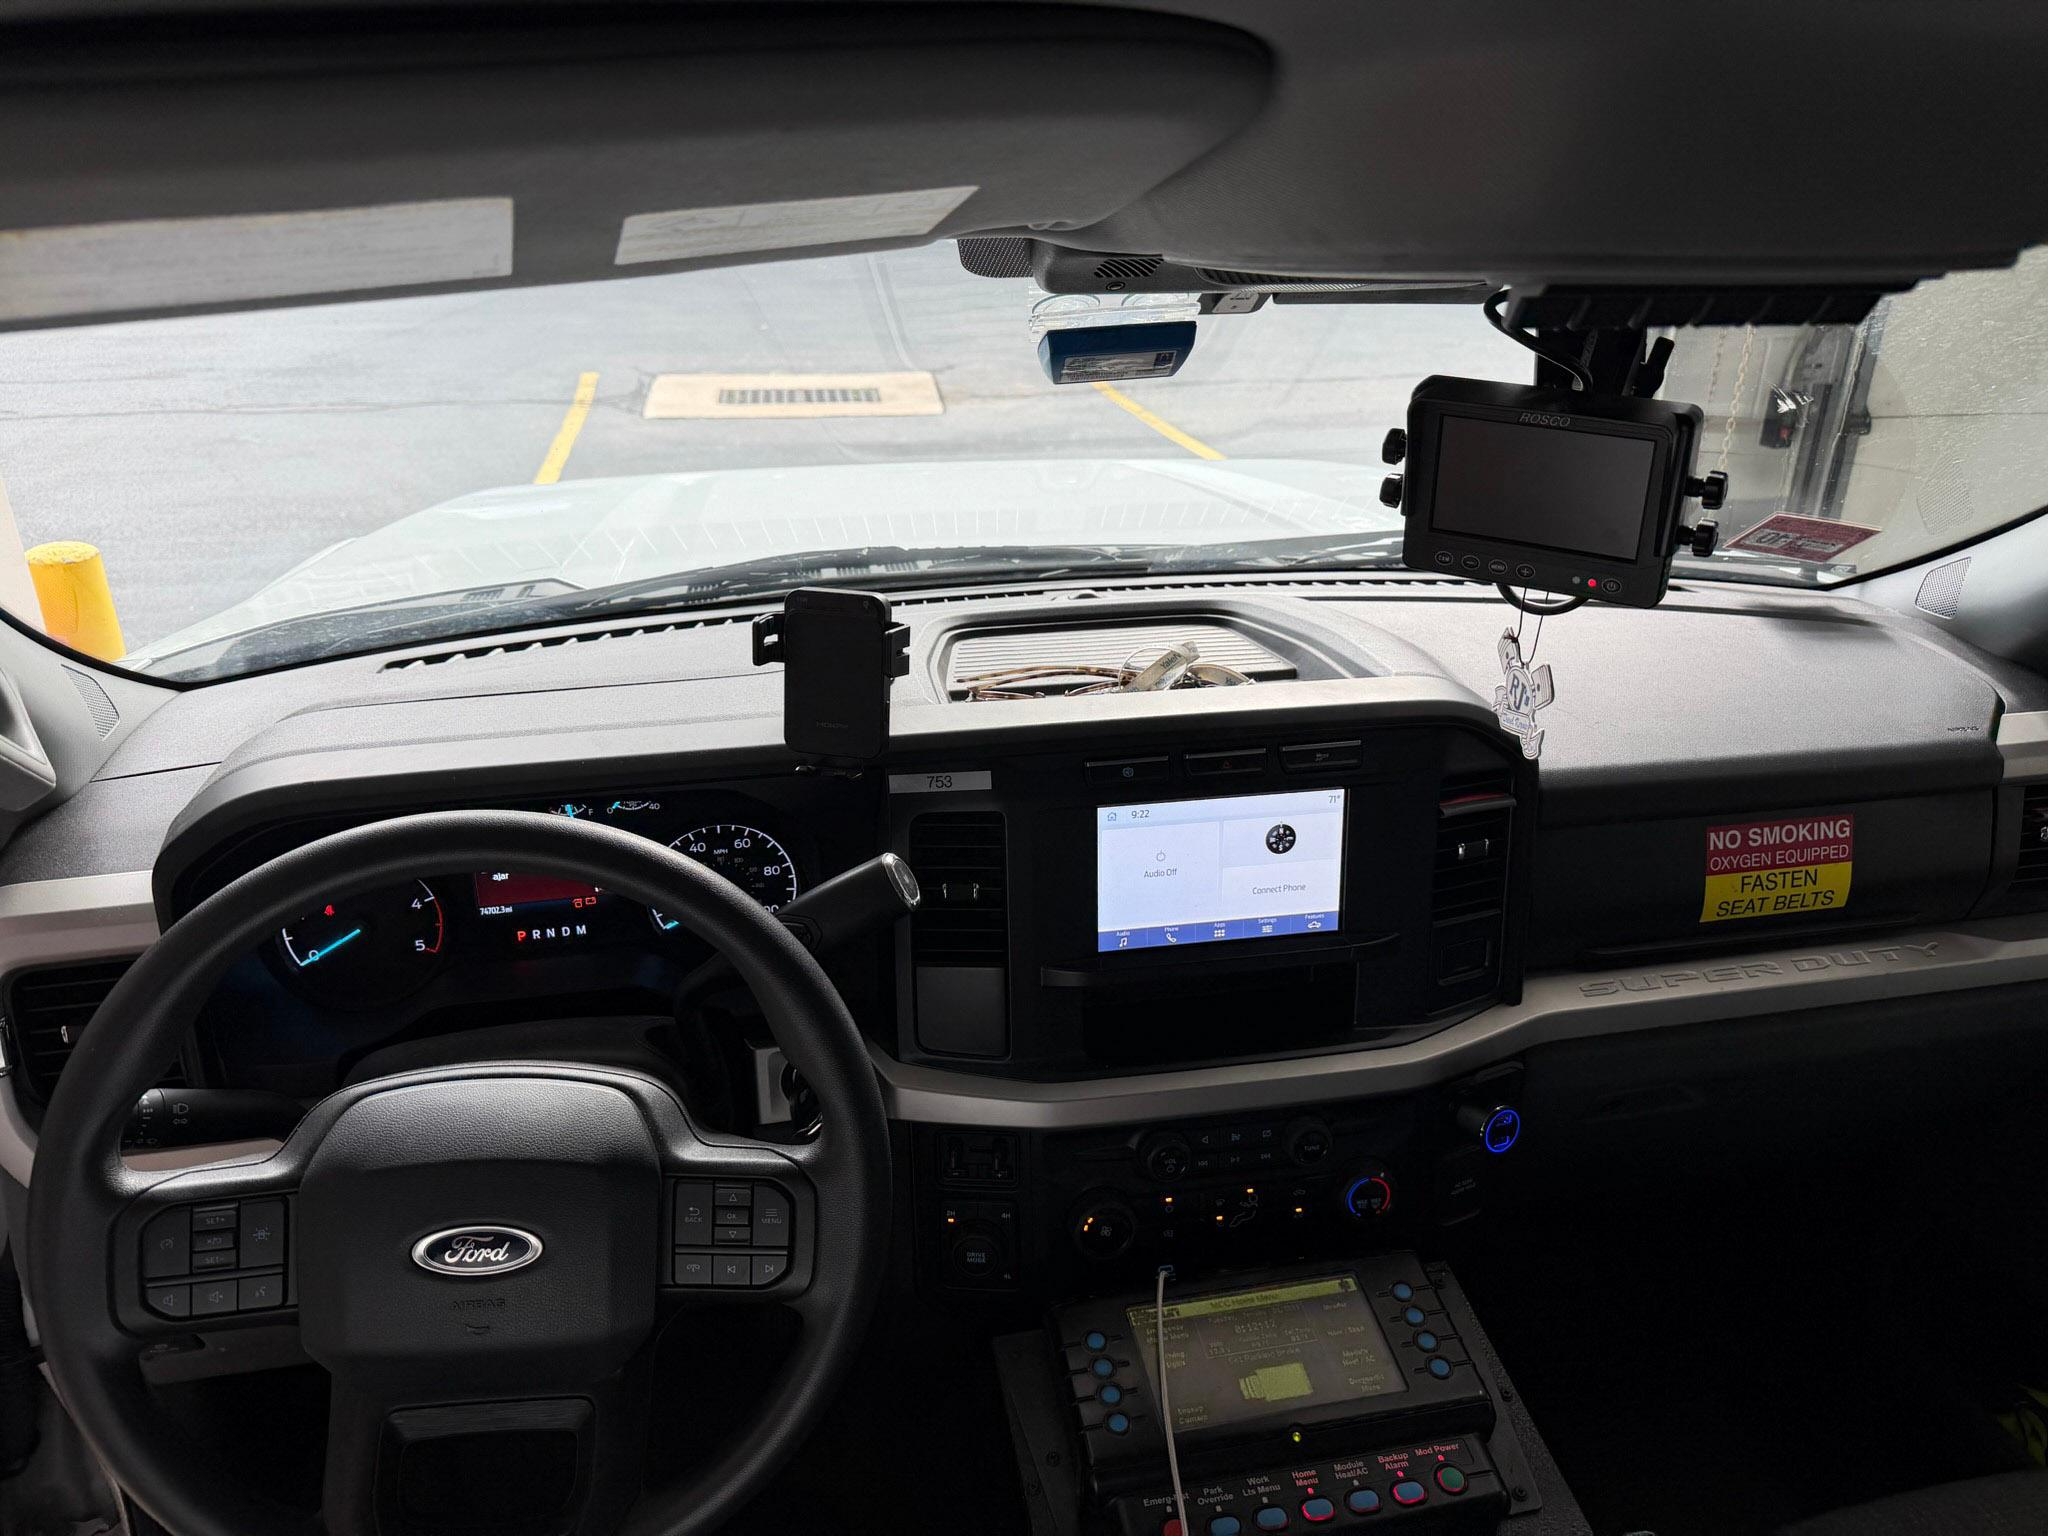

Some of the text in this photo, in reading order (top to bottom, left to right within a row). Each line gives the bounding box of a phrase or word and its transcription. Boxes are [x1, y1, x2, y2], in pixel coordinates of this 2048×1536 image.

[1519, 412, 1571, 427] ROSCO
[926, 775, 953, 789] 753
[1131, 810, 1150, 819] 9:22
[1709, 818, 1851, 851] NO SMOKING
[689, 842, 706, 853] 40
[734, 838, 751, 849] 60
[1709, 844, 1849, 872] OXYGEN EQUIPPED
[491, 872, 510, 881] ajar
[763, 865, 781, 876] 80
[1144, 867, 1178, 878] Audio Off
[1740, 868, 1818, 894] FASTEN
[1252, 883, 1307, 895] Connect Phone
[410, 898, 423, 910] 4
[1715, 889, 1835, 919] SEAT BELTS
[517, 924, 587, 942] P R N D M
[414, 940, 426, 952] 5
[1579, 940, 1940, 999] SUPER DUTY
[444, 1235, 511, 1263] Ford
[1414, 1443, 1459, 1456] Mod Power
[1377, 1452, 1409, 1464] Backup
[1333, 1460, 1364, 1472] Module
[1384, 1460, 1409, 1471] Alarm
[1291, 1469, 1317, 1480] Home
[1334, 1467, 1369, 1480] Heat/AC
[1246, 1475, 1270, 1486] Work
[1295, 1477, 1320, 1487] Menu
[1203, 1485, 1223, 1496] Park
[1242, 1484, 1281, 1497] Lts Menu
[1197, 1493, 1234, 1506] Override
